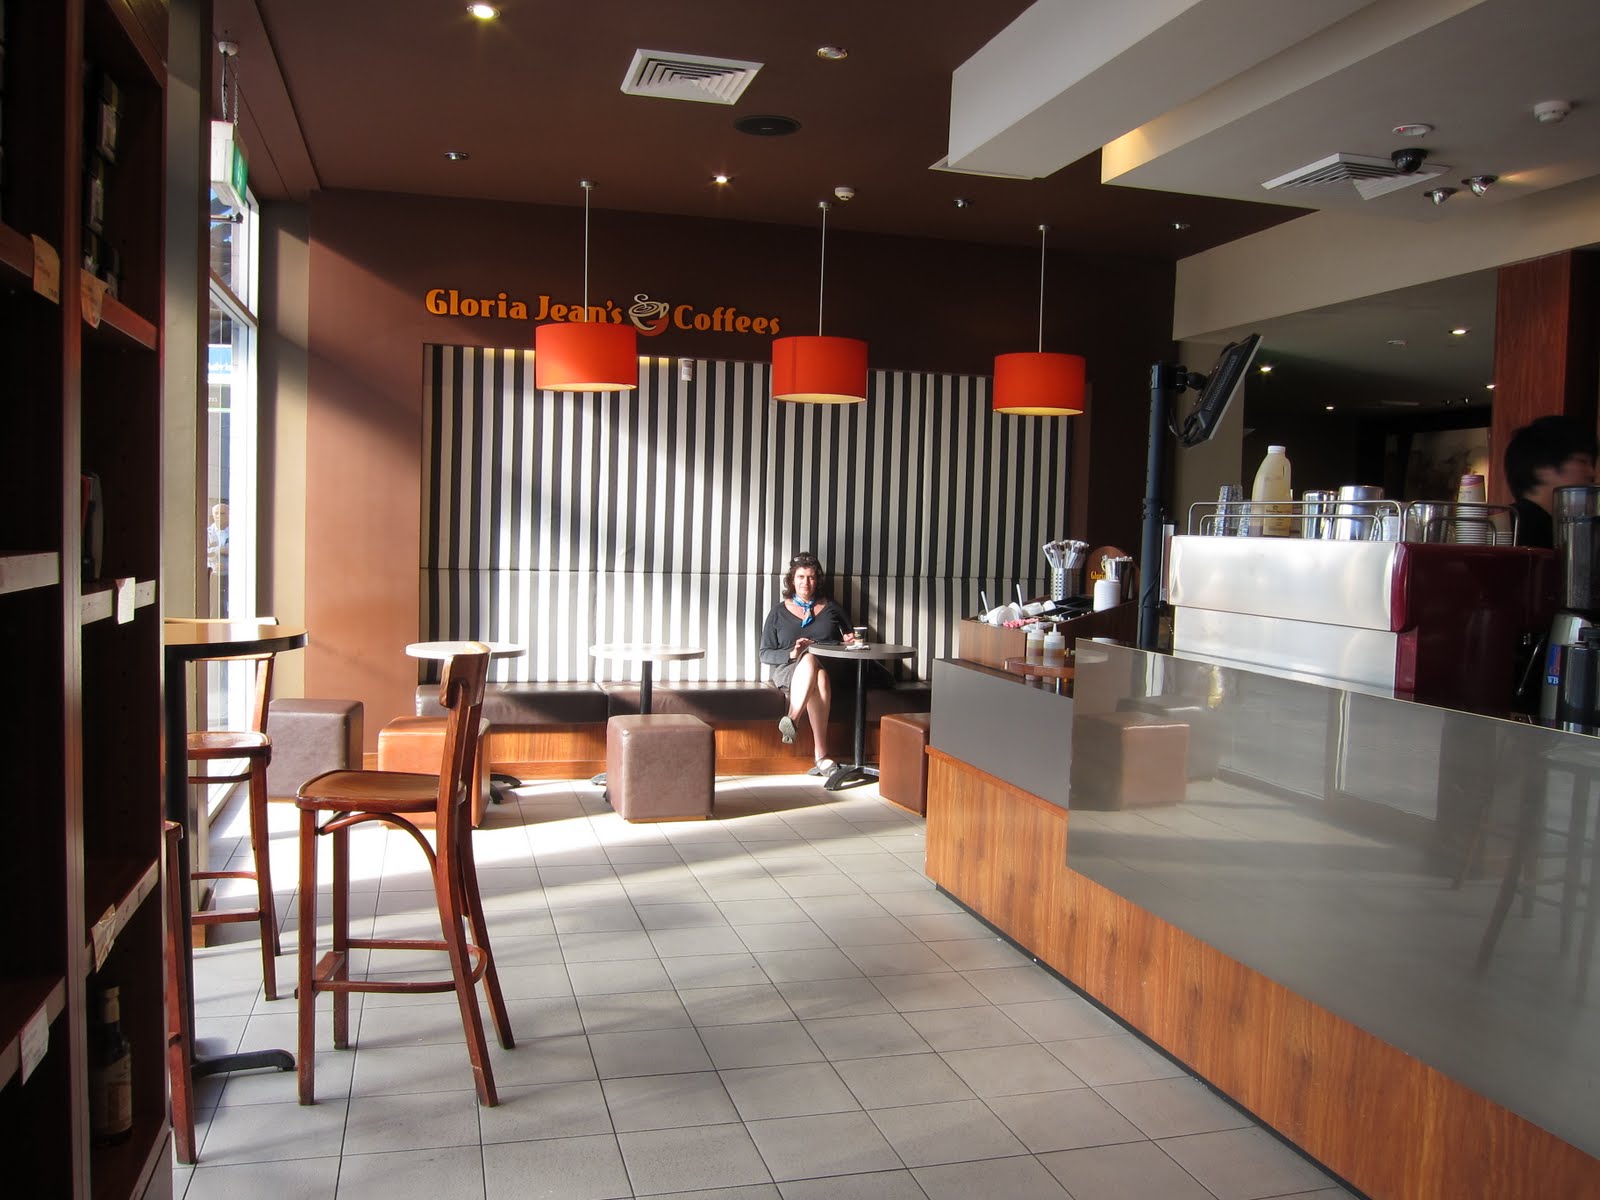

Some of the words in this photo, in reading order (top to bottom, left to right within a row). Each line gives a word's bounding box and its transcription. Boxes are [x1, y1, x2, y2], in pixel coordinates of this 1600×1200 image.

[425, 288, 528, 320] Gloria
[534, 294, 623, 324] Jean's
[673, 304, 781, 335] Coffees
[1090, 571, 1106, 580] Glori
